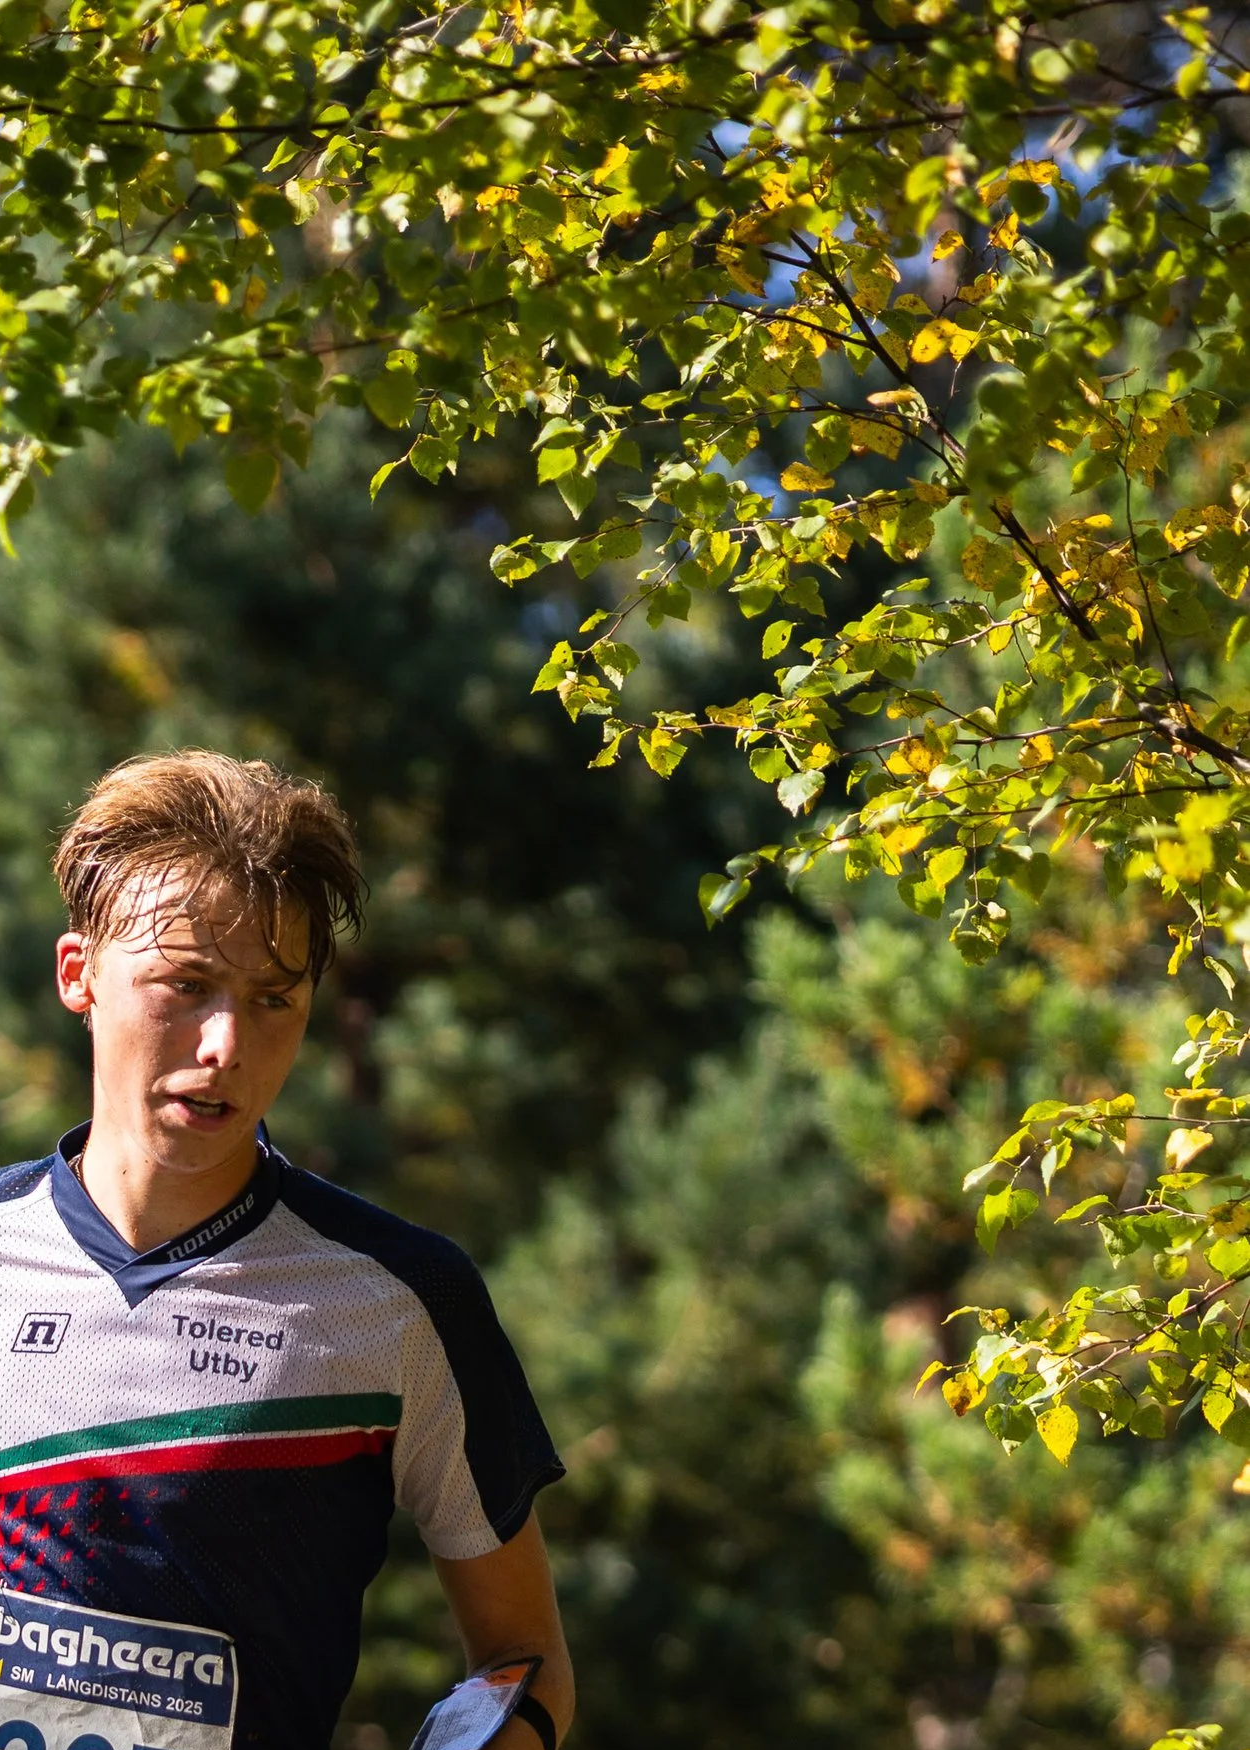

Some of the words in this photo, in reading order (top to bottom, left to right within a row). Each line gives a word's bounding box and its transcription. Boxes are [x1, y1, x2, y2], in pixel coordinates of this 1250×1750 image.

[165, 1193, 255, 1263] noname
[172, 1315, 284, 1350] Tolered
[189, 1350, 258, 1383] Utby
[10, 1665, 35, 1684] SM
[165, 1696, 203, 1716] 2025
